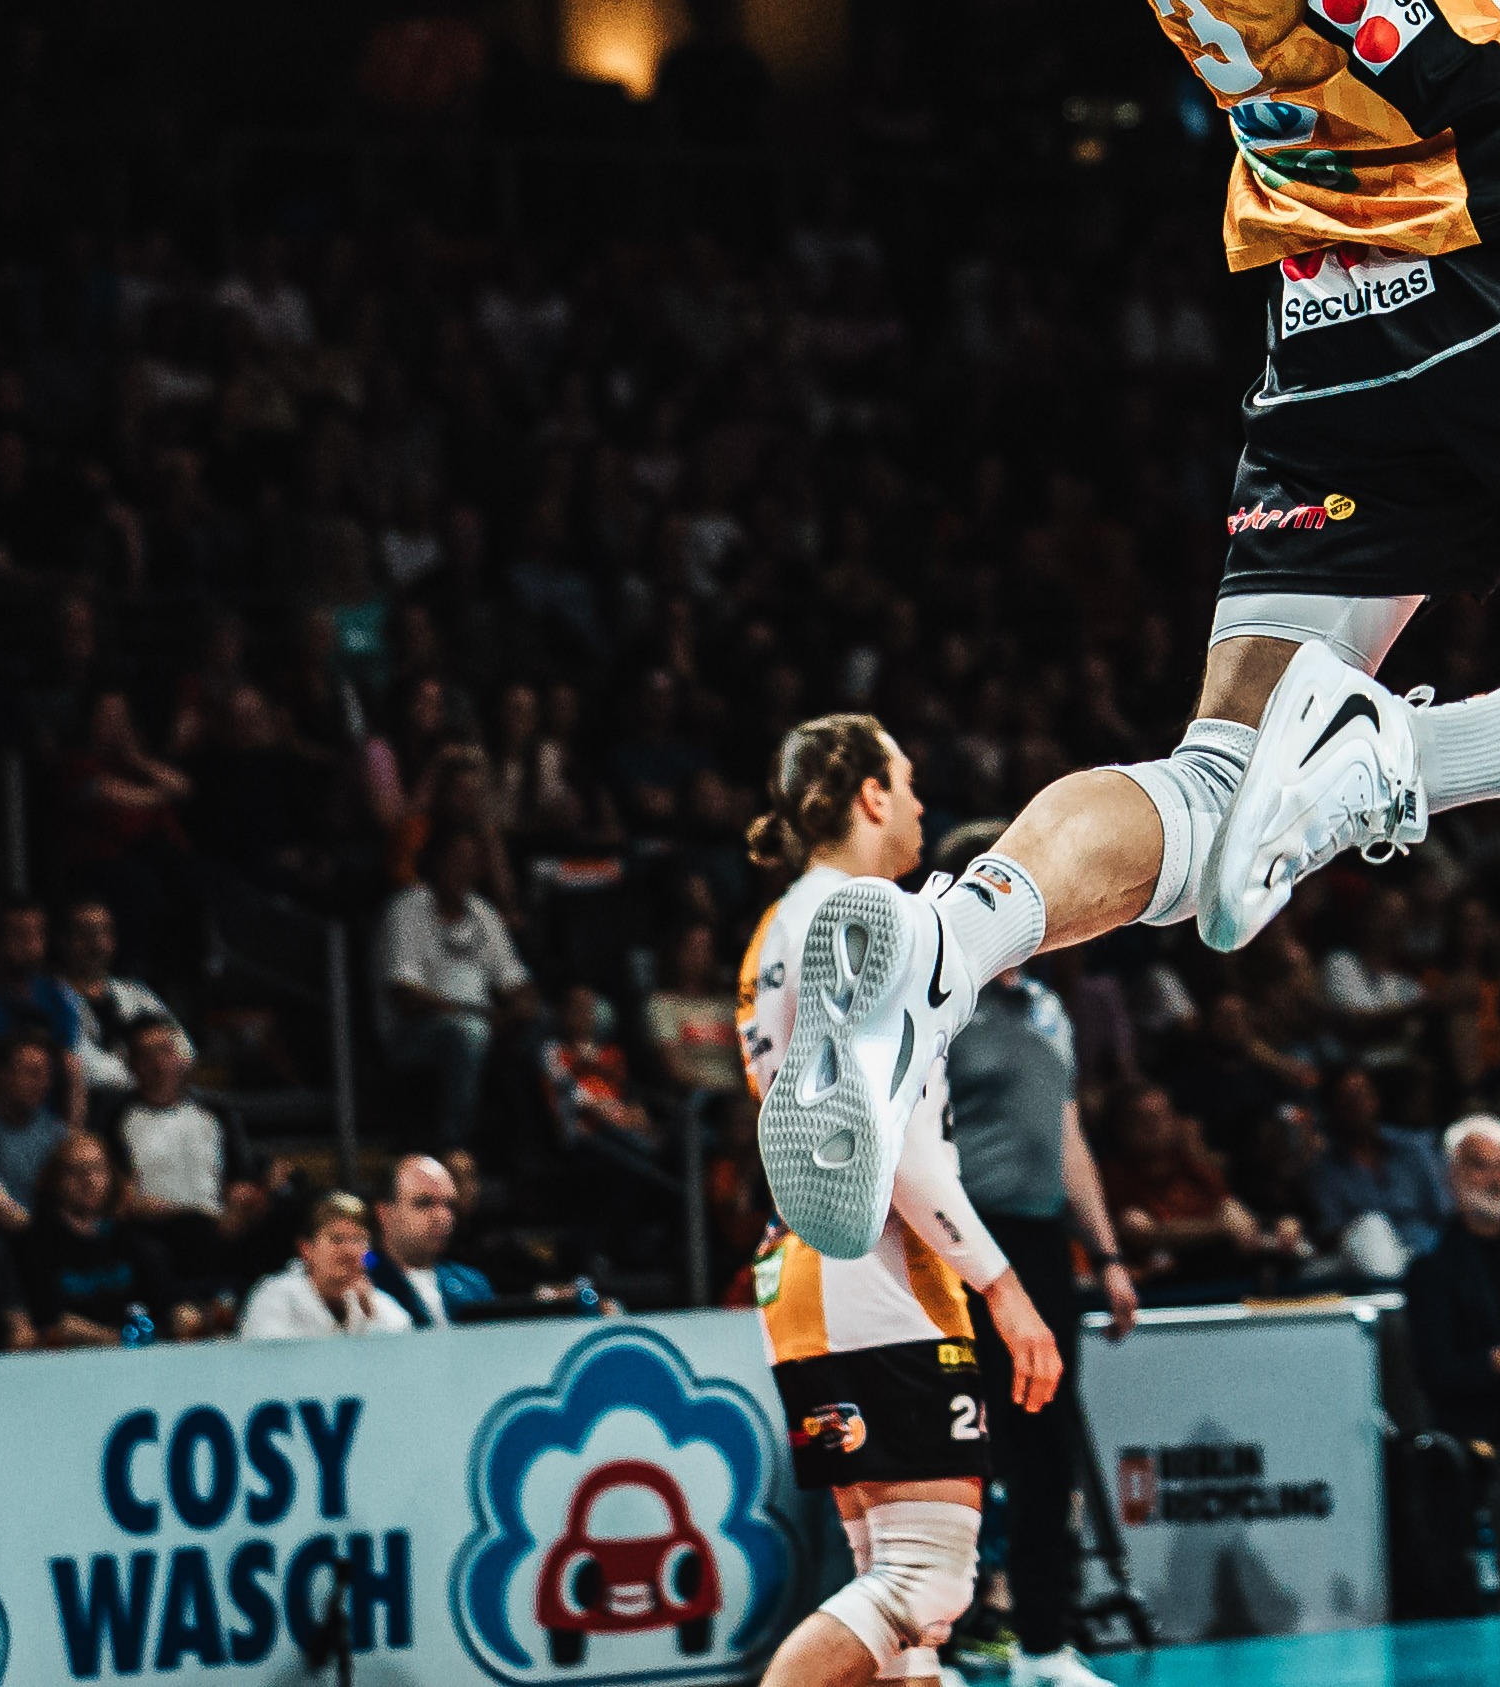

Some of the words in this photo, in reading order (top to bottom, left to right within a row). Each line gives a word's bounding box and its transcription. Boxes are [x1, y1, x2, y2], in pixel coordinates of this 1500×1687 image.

[1284, 268, 1429, 332] Secuitas
[102, 1397, 363, 1536] COSY
[48, 1531, 413, 1680] WASCH
